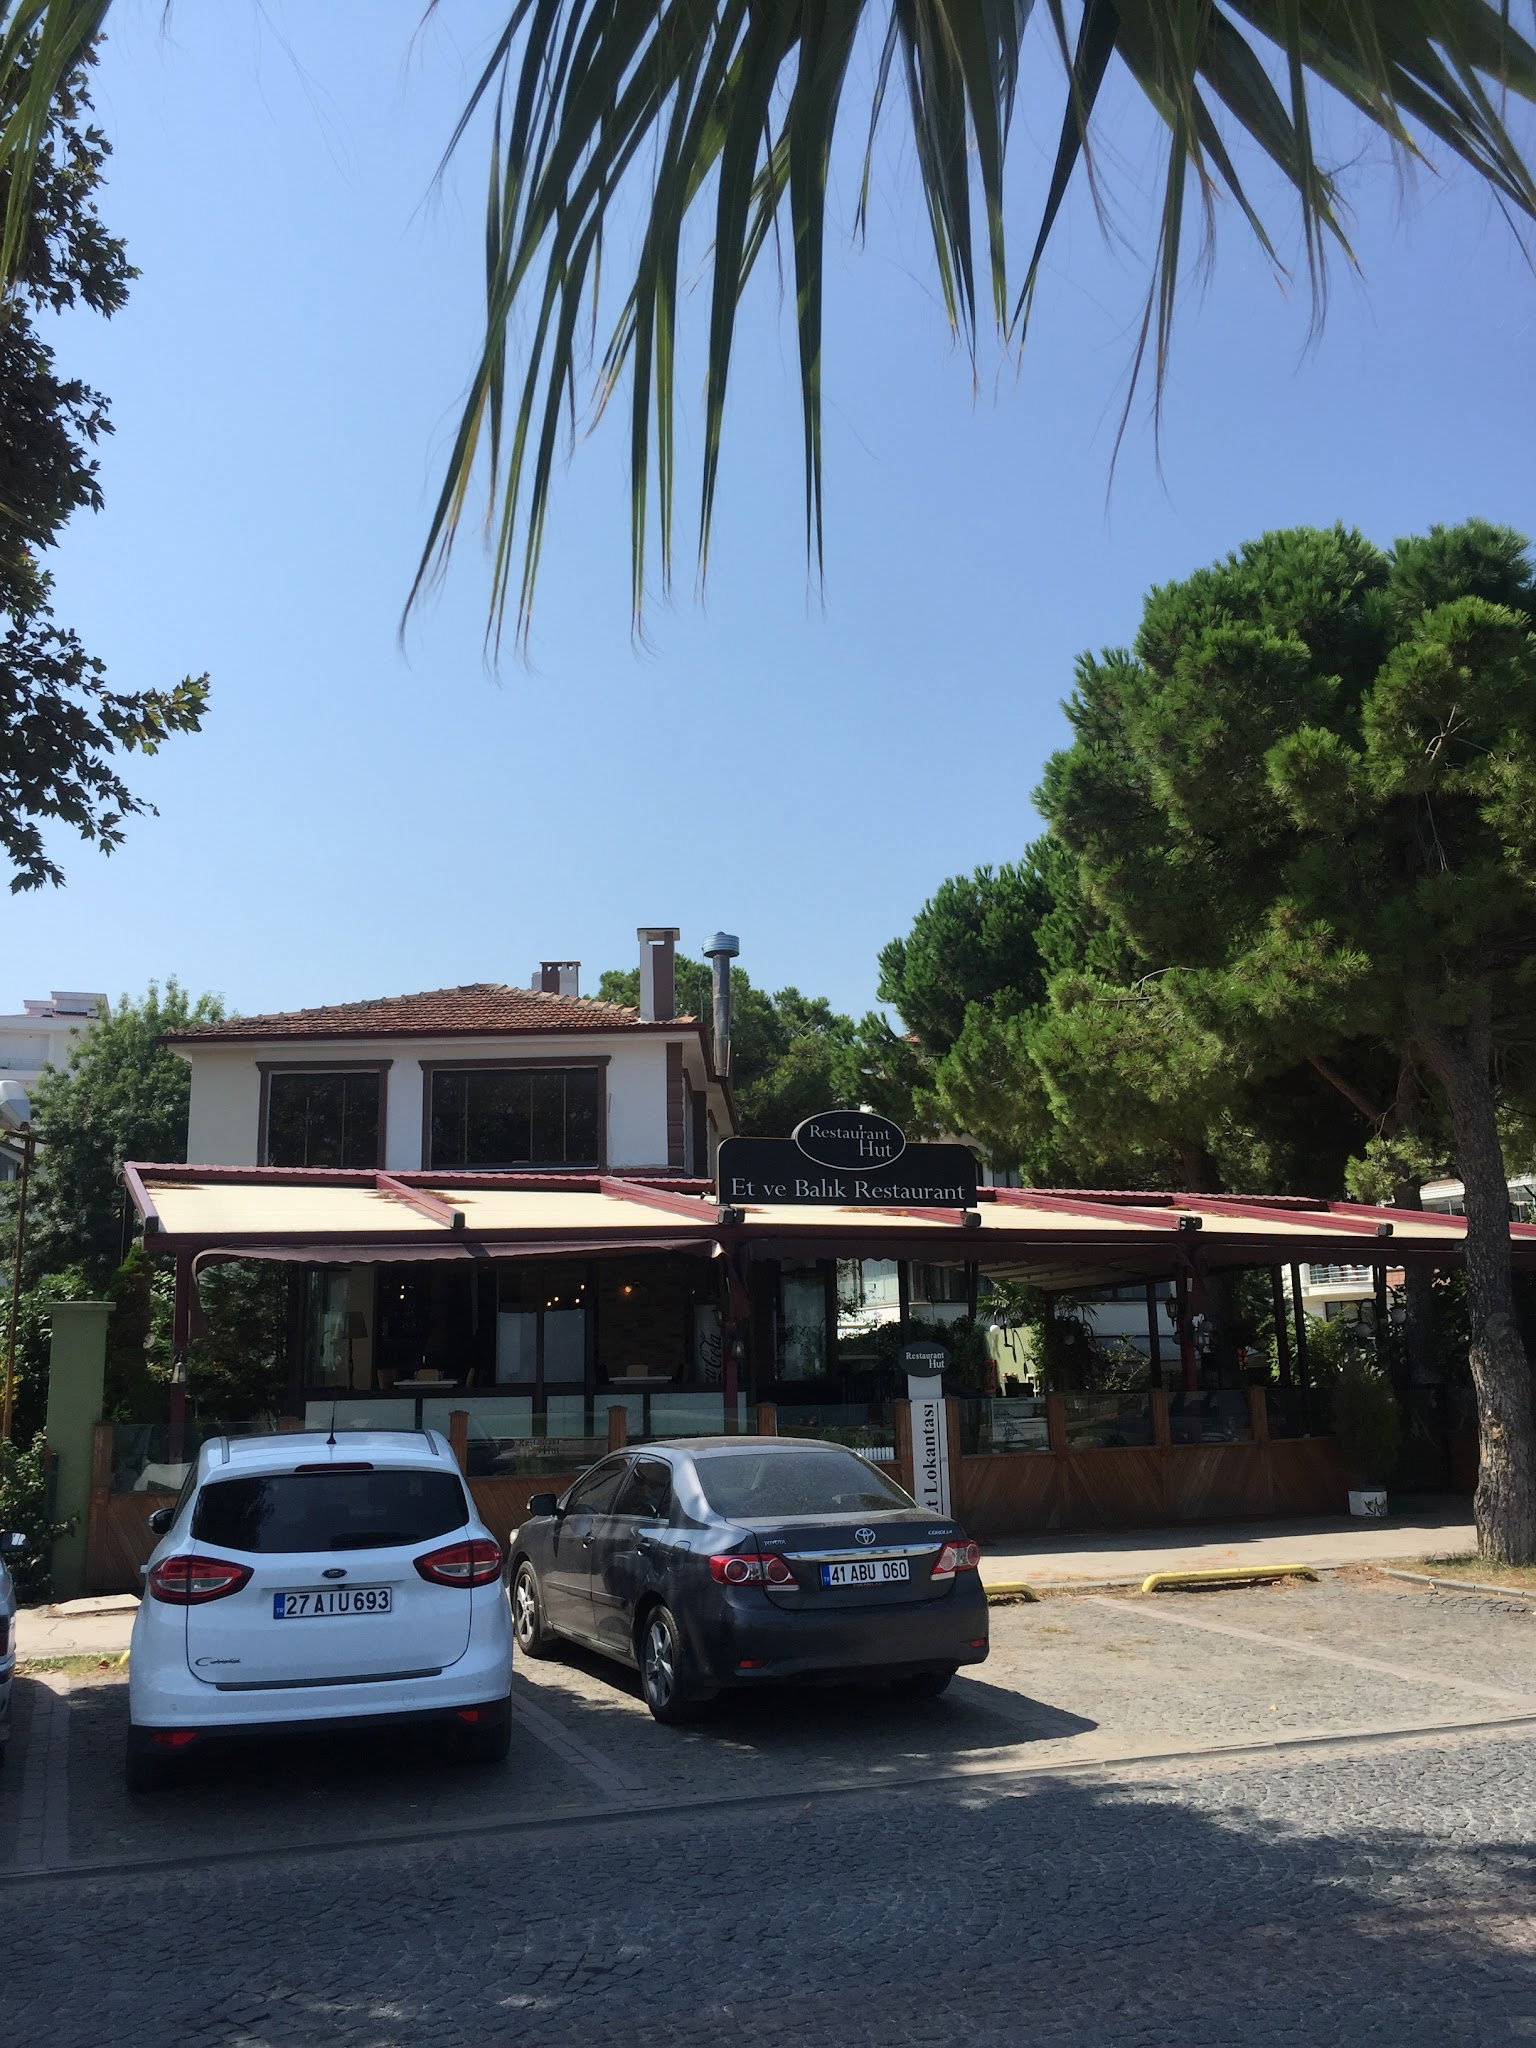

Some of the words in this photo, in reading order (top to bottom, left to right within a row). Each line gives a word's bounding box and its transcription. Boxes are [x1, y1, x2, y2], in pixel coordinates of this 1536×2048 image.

[810, 1124, 890, 1140] Restaurant
[860, 1139, 892, 1157] Hut
[732, 1177, 756, 1196] Et
[763, 1184, 787, 1197] ve
[795, 1178, 847, 1198] Balık
[854, 1179, 965, 1200] Restaurant
[905, 1351, 945, 1360] Restaurant
[928, 1358, 945, 1369] Hut
[923, 1403, 937, 1494] Lokantası
[831, 1565, 846, 1583] 41
[850, 1564, 877, 1582] ABU
[882, 1561, 907, 1579] 060
[286, 1595, 310, 1615] 27
[314, 1592, 350, 1613] AIU
[353, 1590, 389, 1611] 693
